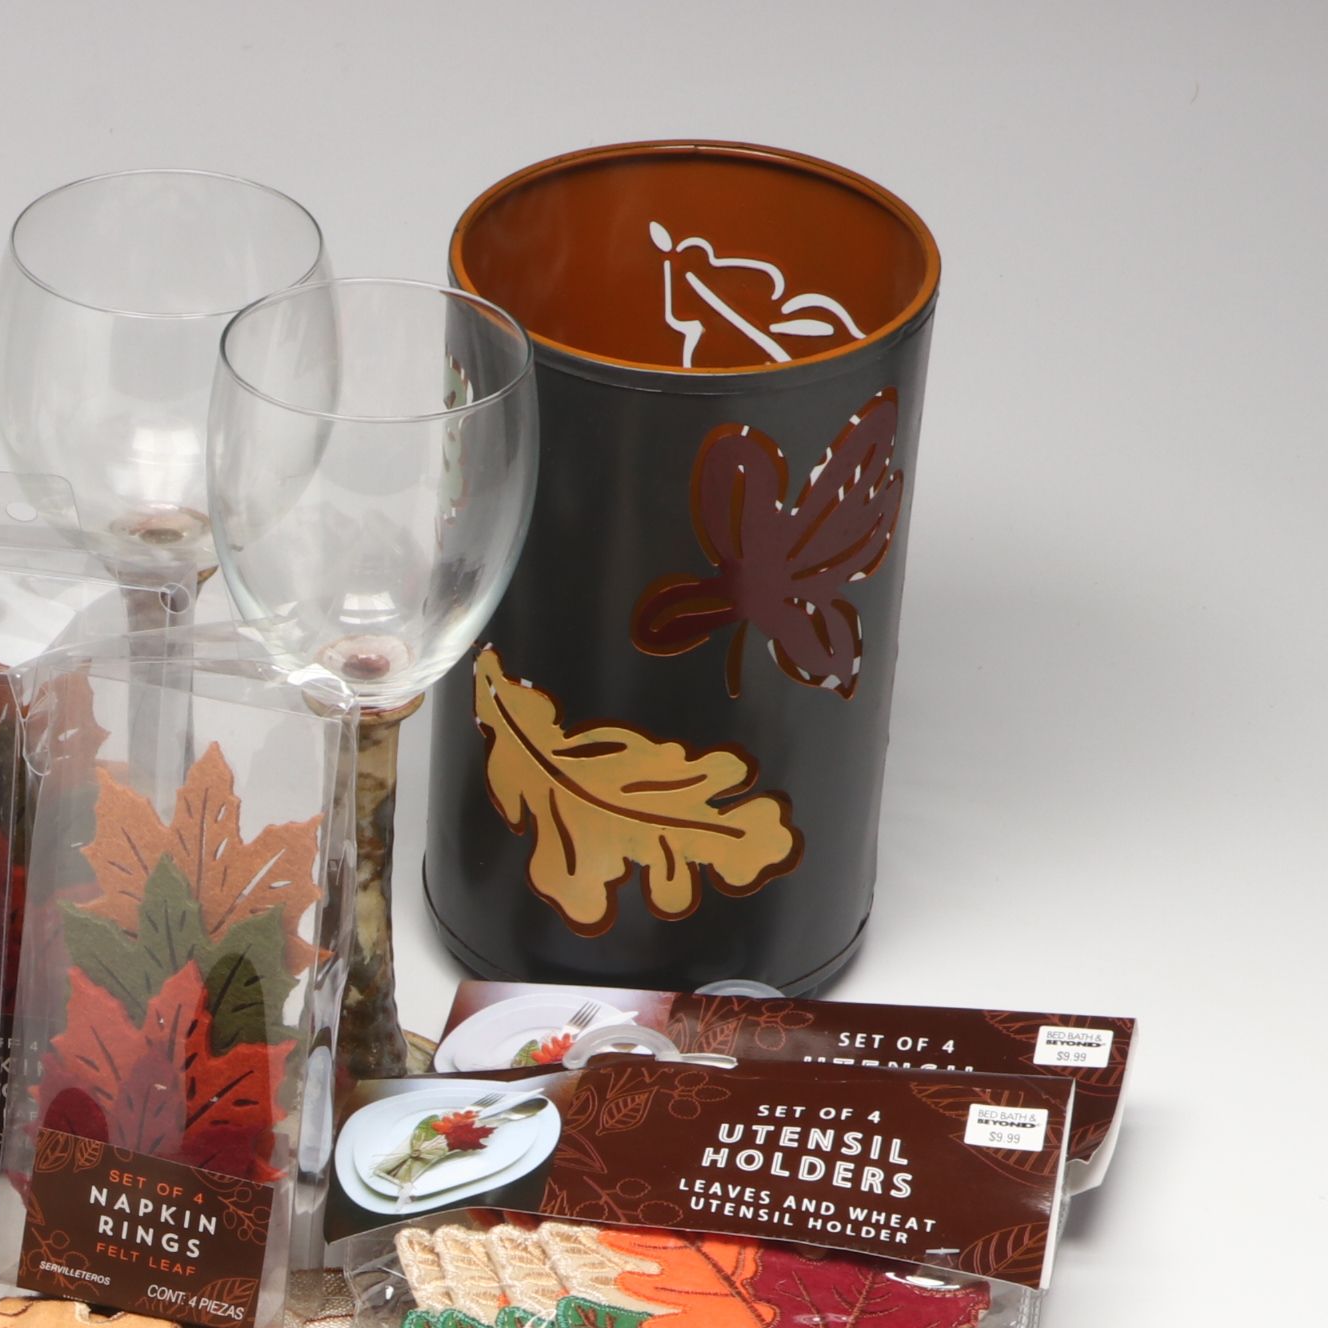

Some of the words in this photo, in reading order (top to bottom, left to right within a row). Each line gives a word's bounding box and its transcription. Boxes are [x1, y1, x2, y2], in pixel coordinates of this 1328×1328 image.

[838, 1031, 884, 1049] SET
[896, 1035, 929, 1052] OF
[942, 1038, 955, 1054] 4
[1046, 1030, 1066, 1039] BED
[1068, 1031, 1093, 1041] BATH
[1057, 1051, 1087, 1062] $9.99
[757, 1104, 806, 1119] SET
[819, 1107, 854, 1121] OF
[868, 1109, 881, 1124] 4
[978, 1109, 999, 1119] BED
[1000, 1111, 1027, 1122] BATH
[718, 1123, 910, 1167] UTENSIL
[988, 1131, 1021, 1144] $9.99
[108, 1169, 146, 1190] SET
[156, 1182, 184, 1199] OF
[193, 1192, 205, 1205] 4
[700, 1147, 913, 1199] HOLDERS
[89, 1184, 217, 1236] NAPKIN
[678, 1177, 773, 1206] LEAVES
[783, 1194, 835, 1216] AND
[848, 1205, 937, 1232] WHEAT
[689, 1197, 795, 1227] UTENSIL
[807, 1217, 910, 1244] HOLDER
[98, 1215, 201, 1259] RINGS
[39, 1260, 111, 1286] SERVILLETEROS
[95, 1242, 140, 1263] FELT
[148, 1256, 198, 1277] LEAF
[146, 1283, 186, 1306] CONT:
[188, 1295, 198, 1308] 4
[198, 1297, 245, 1321] PIEZAS
